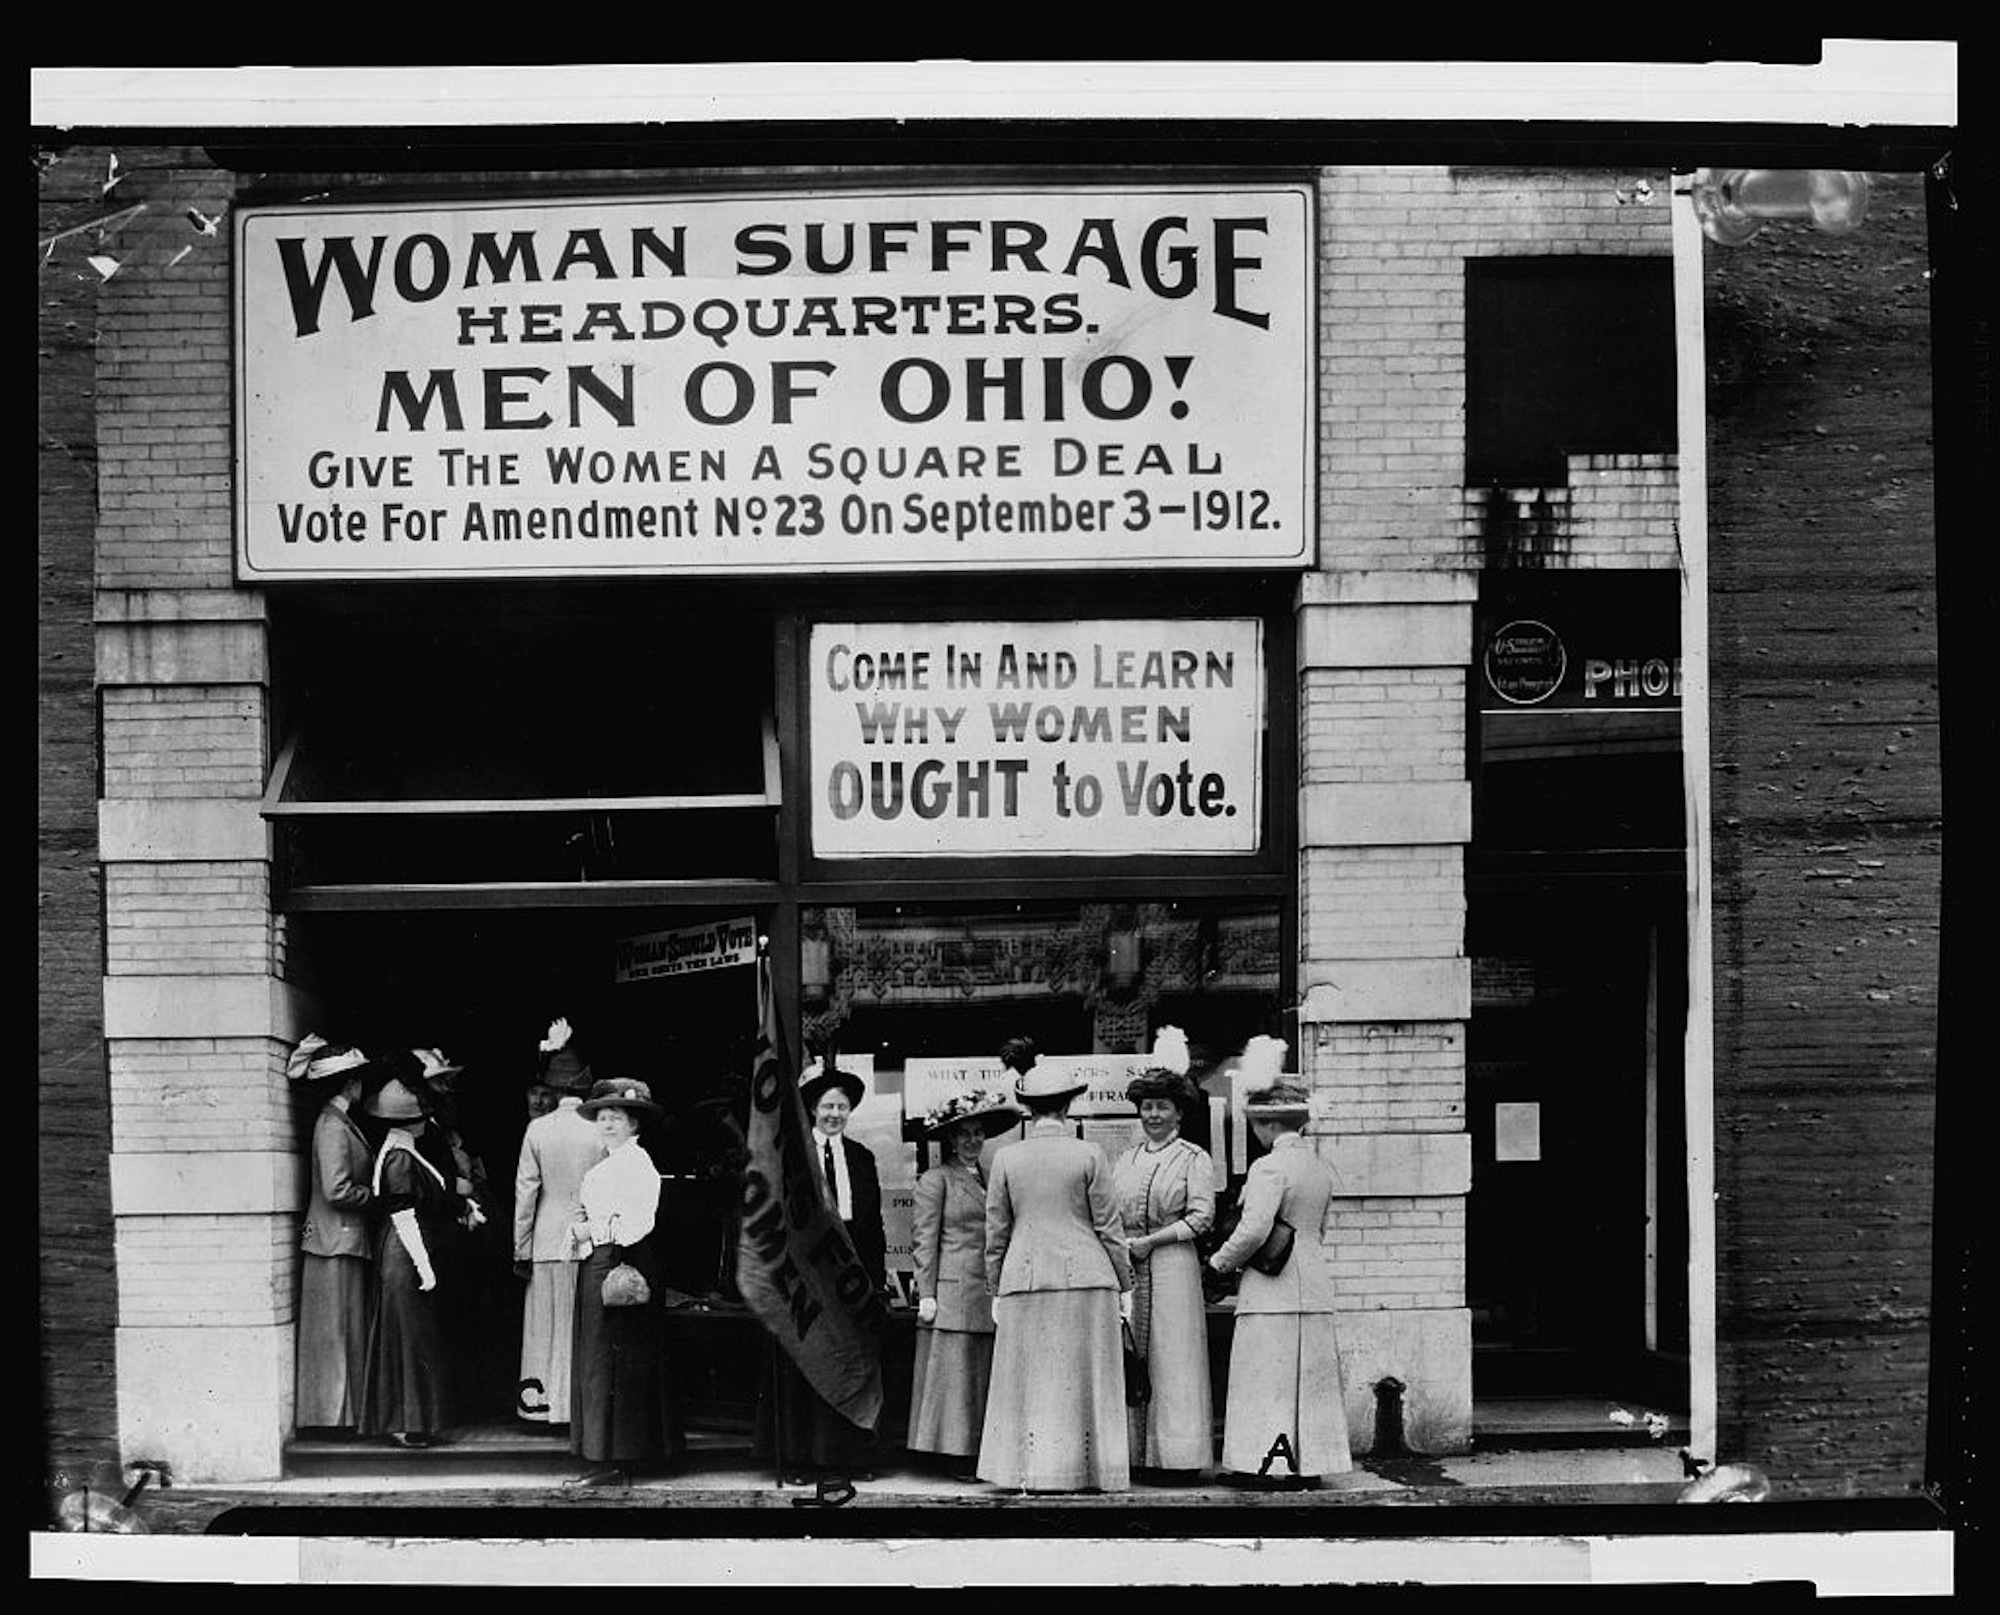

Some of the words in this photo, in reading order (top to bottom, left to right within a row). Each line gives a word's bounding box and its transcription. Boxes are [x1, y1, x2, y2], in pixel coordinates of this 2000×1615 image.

[276, 225, 687, 338] WOMAN
[734, 216, 1271, 331] SUFFRAGE
[457, 293, 1099, 348] HEADQUARTERS.
[375, 365, 636, 432] MEN
[684, 360, 837, 426] OF
[880, 354, 1195, 424] OHIO!
[308, 450, 414, 489] GIVE
[438, 446, 520, 486] THE
[546, 446, 725, 485] WOMEN
[751, 445, 782, 481] A
[807, 442, 1022, 481] SQUARE
[1054, 437, 1222, 477] DEAL
[277, 503, 367, 544] Vote
[382, 503, 448, 542] For
[462, 498, 698, 541] Amendment
[841, 494, 893, 535] On
[903, 489, 1115, 541] September
[825, 643, 931, 693] COME
[946, 643, 983, 690] IN
[995, 642, 1078, 690] AND
[1093, 643, 1236, 691] LEARN
[854, 701, 967, 746] WHY
[987, 701, 1192, 745] WOMEN
[827, 758, 1030, 821] OUGHT
[1051, 759, 1104, 819] to
[1115, 758, 1238, 819] Vote.
[926, 1069, 969, 1081] WHAT
